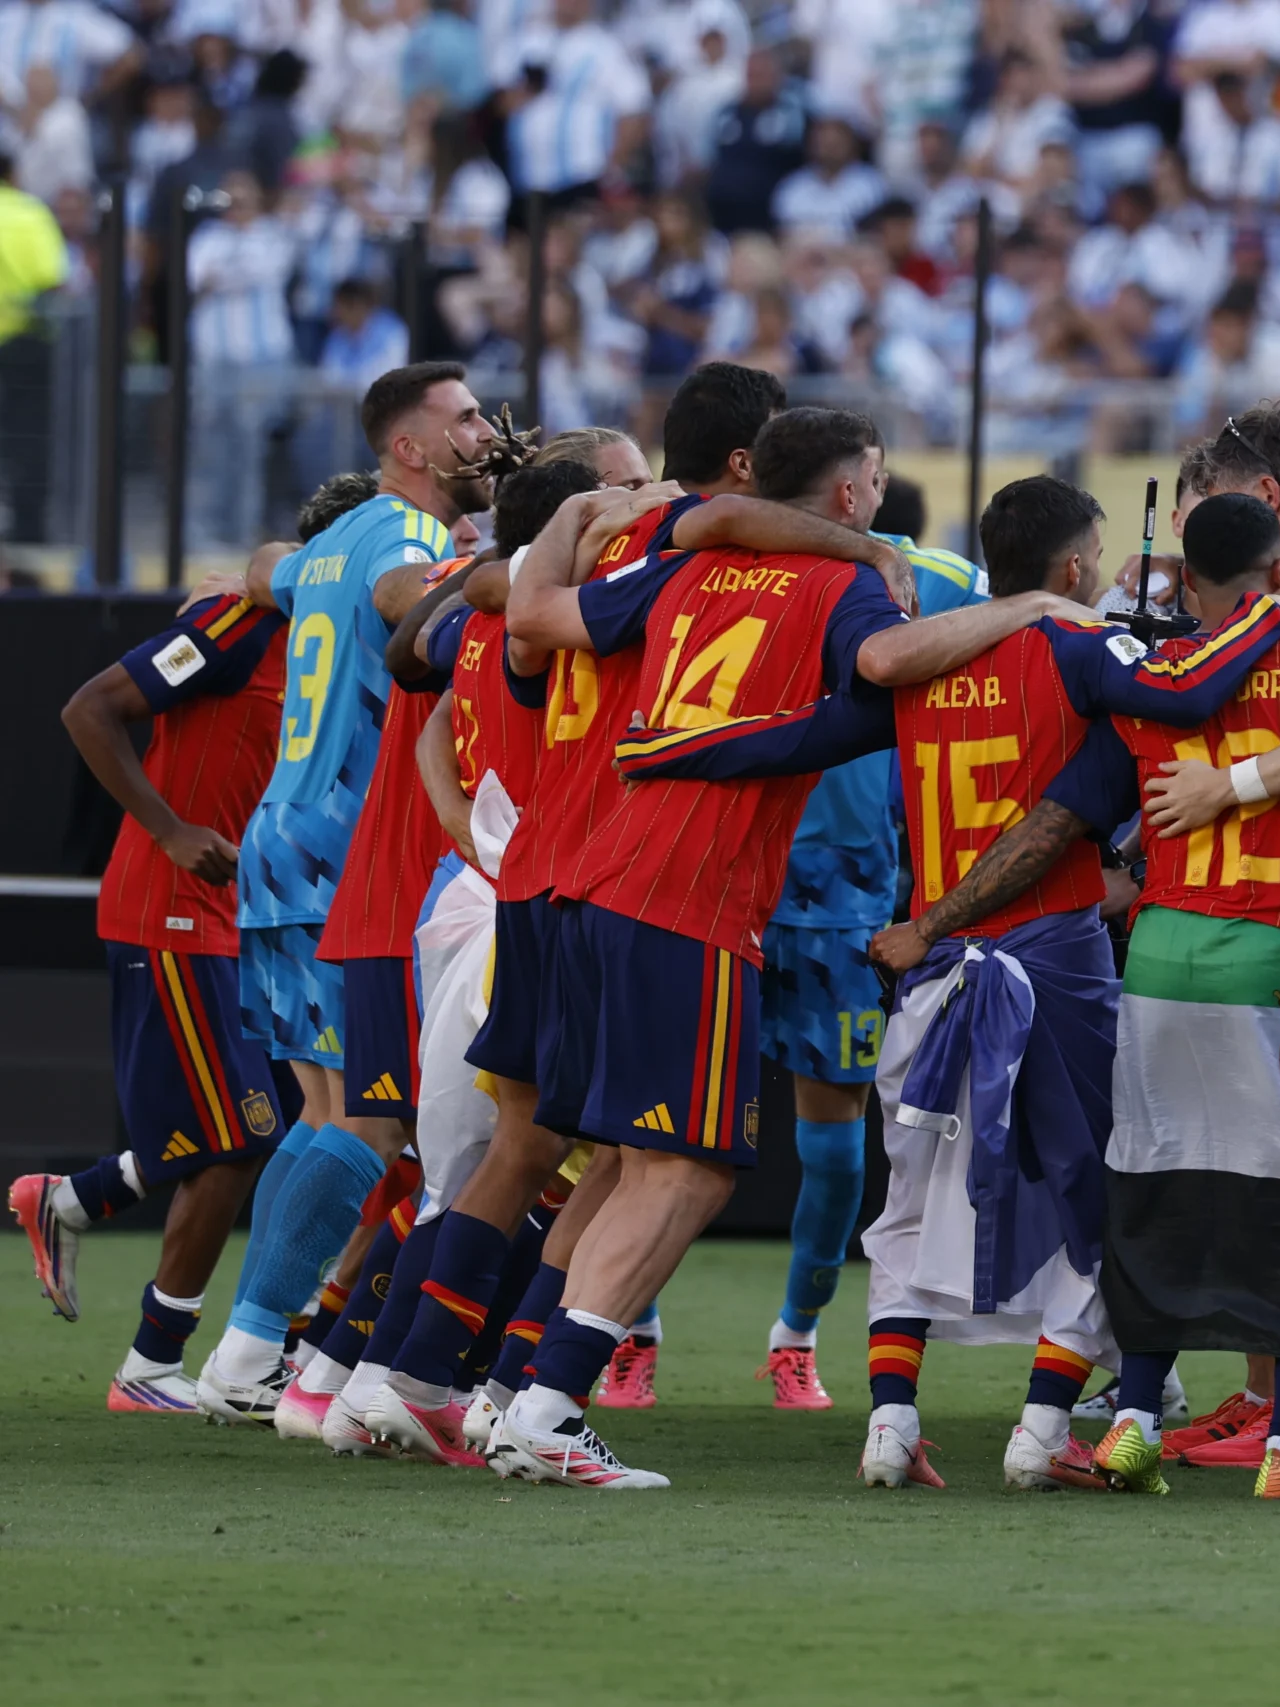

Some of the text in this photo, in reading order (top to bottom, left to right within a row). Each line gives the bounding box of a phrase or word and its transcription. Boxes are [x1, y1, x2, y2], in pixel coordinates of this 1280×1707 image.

[277, 612, 336, 763] 3
[648, 613, 768, 729] 14
[926, 676, 1007, 708] ALEX B.
[837, 1009, 885, 1069] 13
